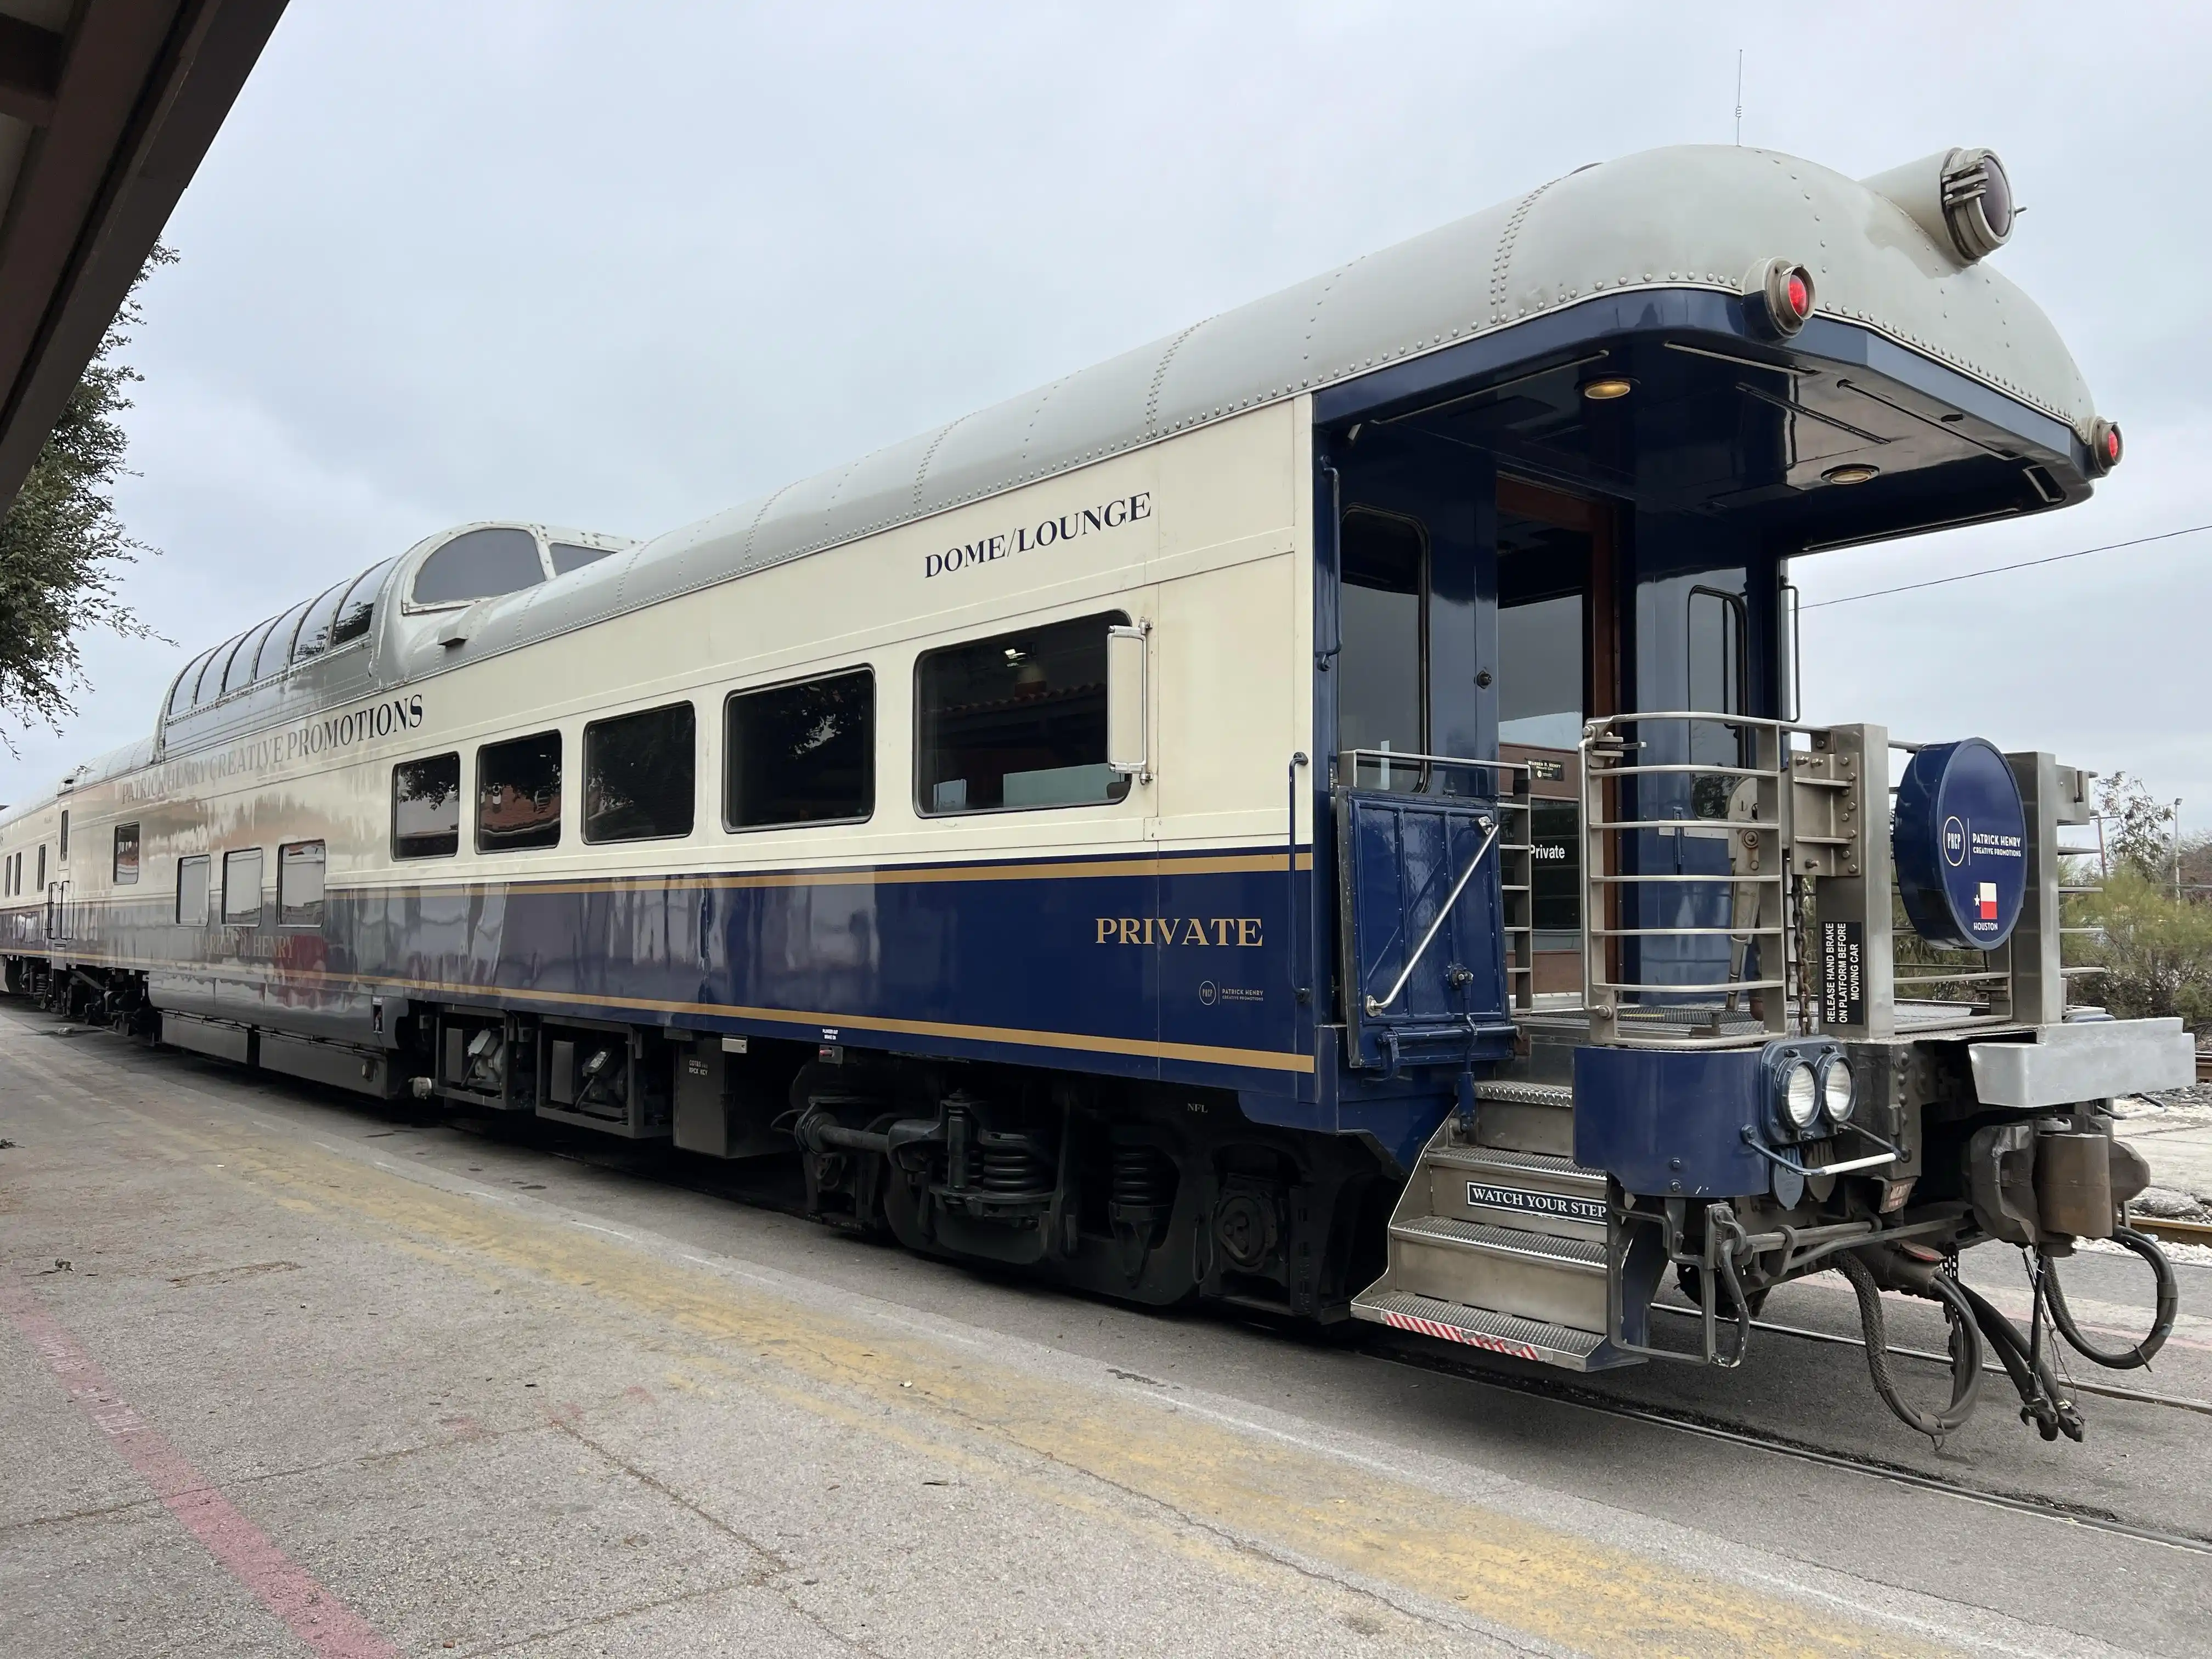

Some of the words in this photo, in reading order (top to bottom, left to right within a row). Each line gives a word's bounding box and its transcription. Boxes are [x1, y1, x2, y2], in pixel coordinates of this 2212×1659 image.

[925, 492, 1152, 578] DOME/LOUNGE
[122, 769, 165, 804] PATRICK
[210, 735, 283, 780] CREATIVE
[287, 693, 423, 760] PROMOTIONS
[1531, 844, 1565, 859] Private
[1948, 833, 1961, 850] PHCP
[1973, 833, 1999, 845] PATRICK
[2000, 836, 2021, 847] HENRY
[1973, 847, 1994, 855] CREATIVE
[1994, 848, 2022, 857] PROMOTIONS
[1095, 918, 1263, 946] PRIVATE
[1826, 923, 1835, 953] BRAKE
[1973, 922, 1998, 931] HOUSTON
[253, 934, 295, 959] HENRY
[1837, 923, 1847, 958] BEFORE
[1850, 944, 1859, 963] CAR
[1826, 955, 1835, 980] HAND
[1838, 961, 1848, 1008] PLATFORM
[1850, 965, 1859, 1000] MOVING
[1827, 982, 1836, 1023] RELEASE
[1839, 1010, 1848, 1023] ON
[1187, 1103, 1209, 1113] NFL
[1472, 1188, 1523, 1206] WATCH
[1526, 1195, 1568, 1212] YOUR
[1571, 1201, 1607, 1217] STEP
